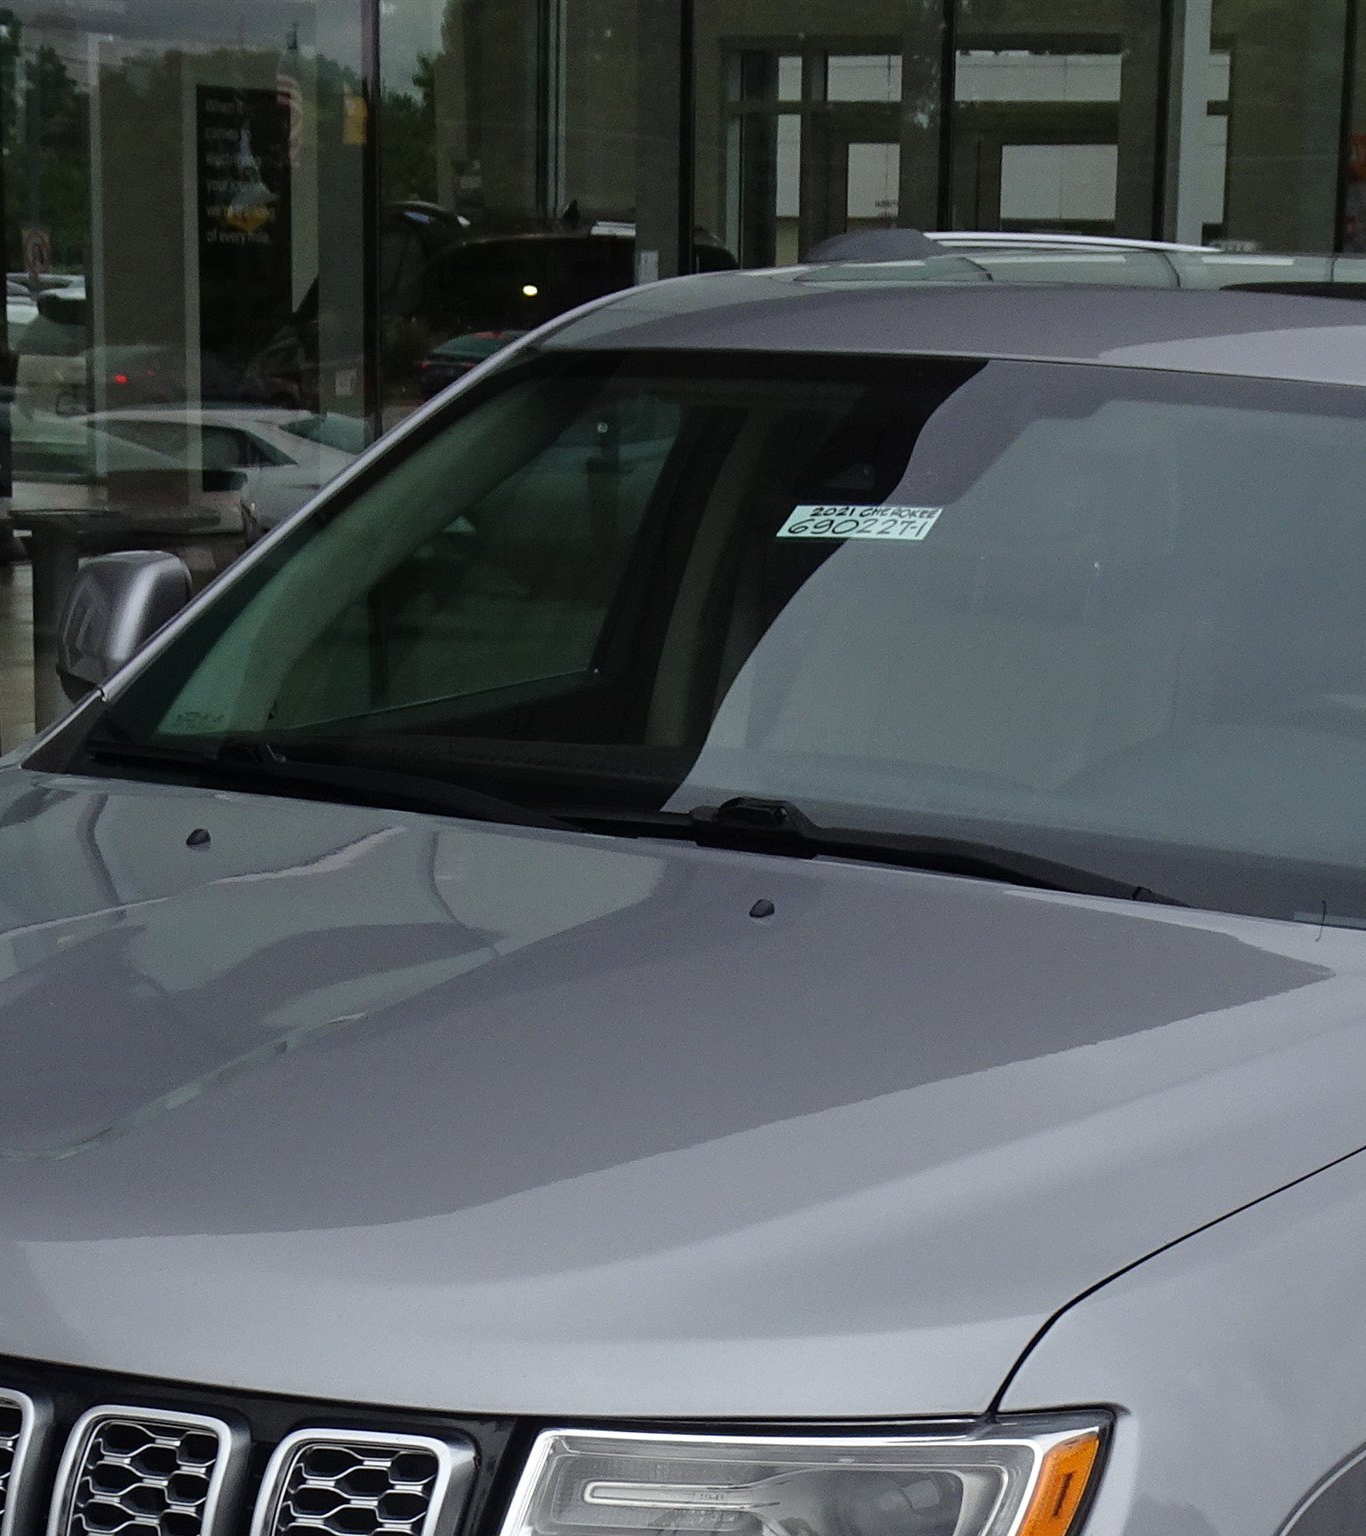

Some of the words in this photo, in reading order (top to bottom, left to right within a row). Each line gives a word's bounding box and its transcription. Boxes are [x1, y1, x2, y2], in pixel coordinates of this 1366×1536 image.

[810, 507, 856, 517] 2021
[859, 507, 939, 519] CHEROKEE
[787, 518, 928, 538] 690227-1
